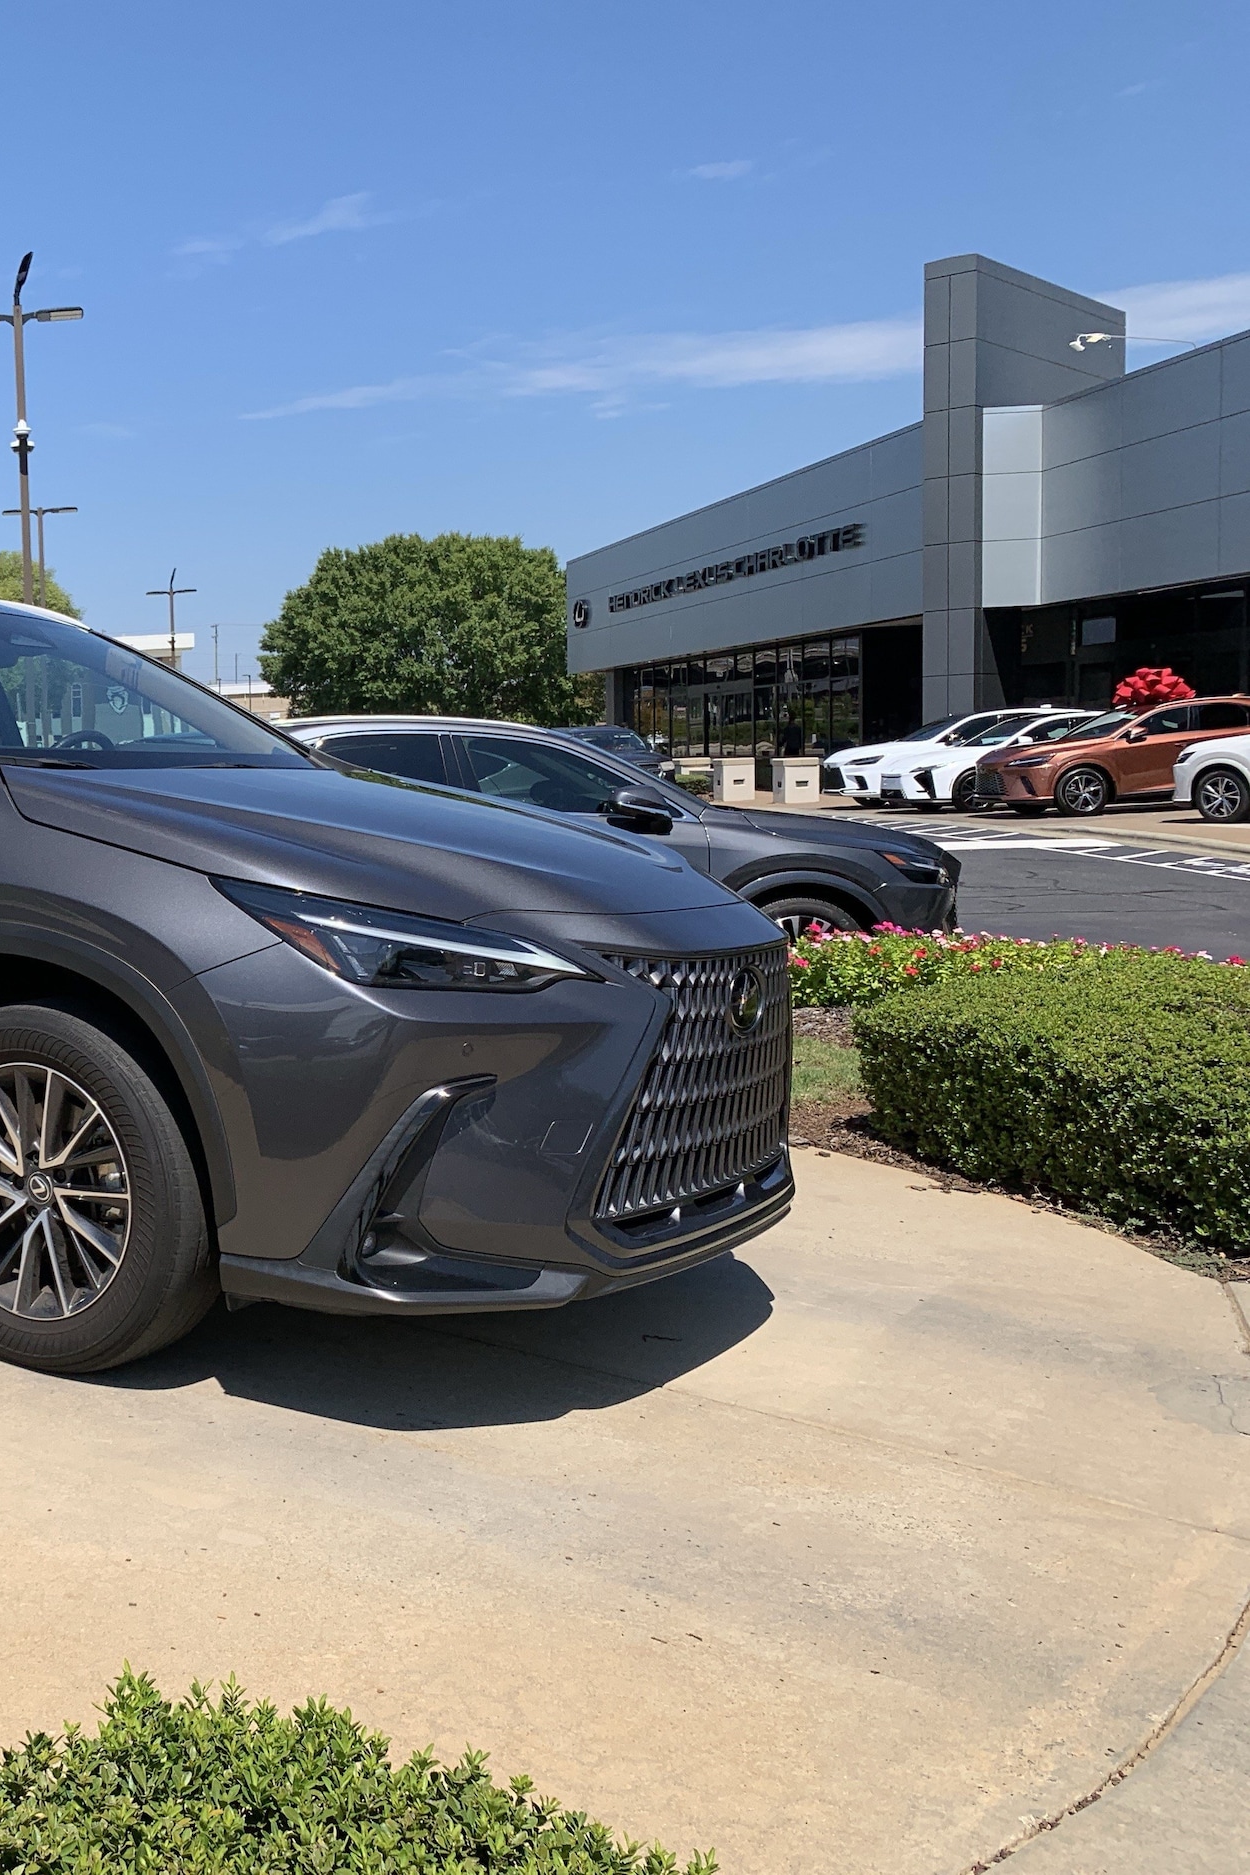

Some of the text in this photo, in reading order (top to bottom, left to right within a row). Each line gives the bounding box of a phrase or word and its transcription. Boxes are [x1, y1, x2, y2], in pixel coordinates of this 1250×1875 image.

[608, 523, 867, 613] HENDRICK LEXUS CHARLOTTE
